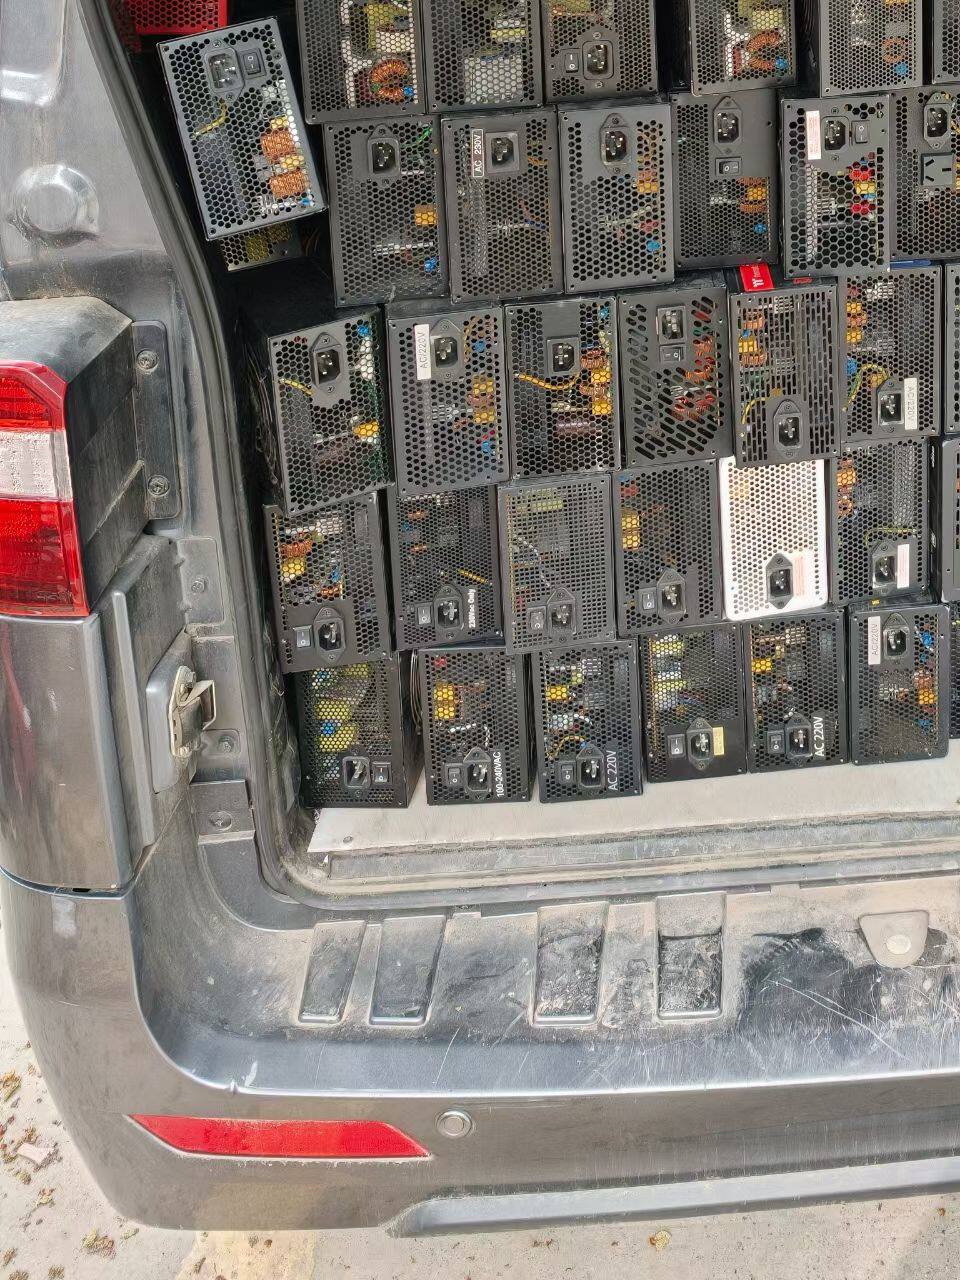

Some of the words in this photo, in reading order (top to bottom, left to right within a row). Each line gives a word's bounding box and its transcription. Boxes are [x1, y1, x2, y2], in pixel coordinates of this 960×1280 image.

[474, 161, 482, 172] AC
[468, 589, 476, 604] Only
[493, 752, 504, 797] 100-240VAC
